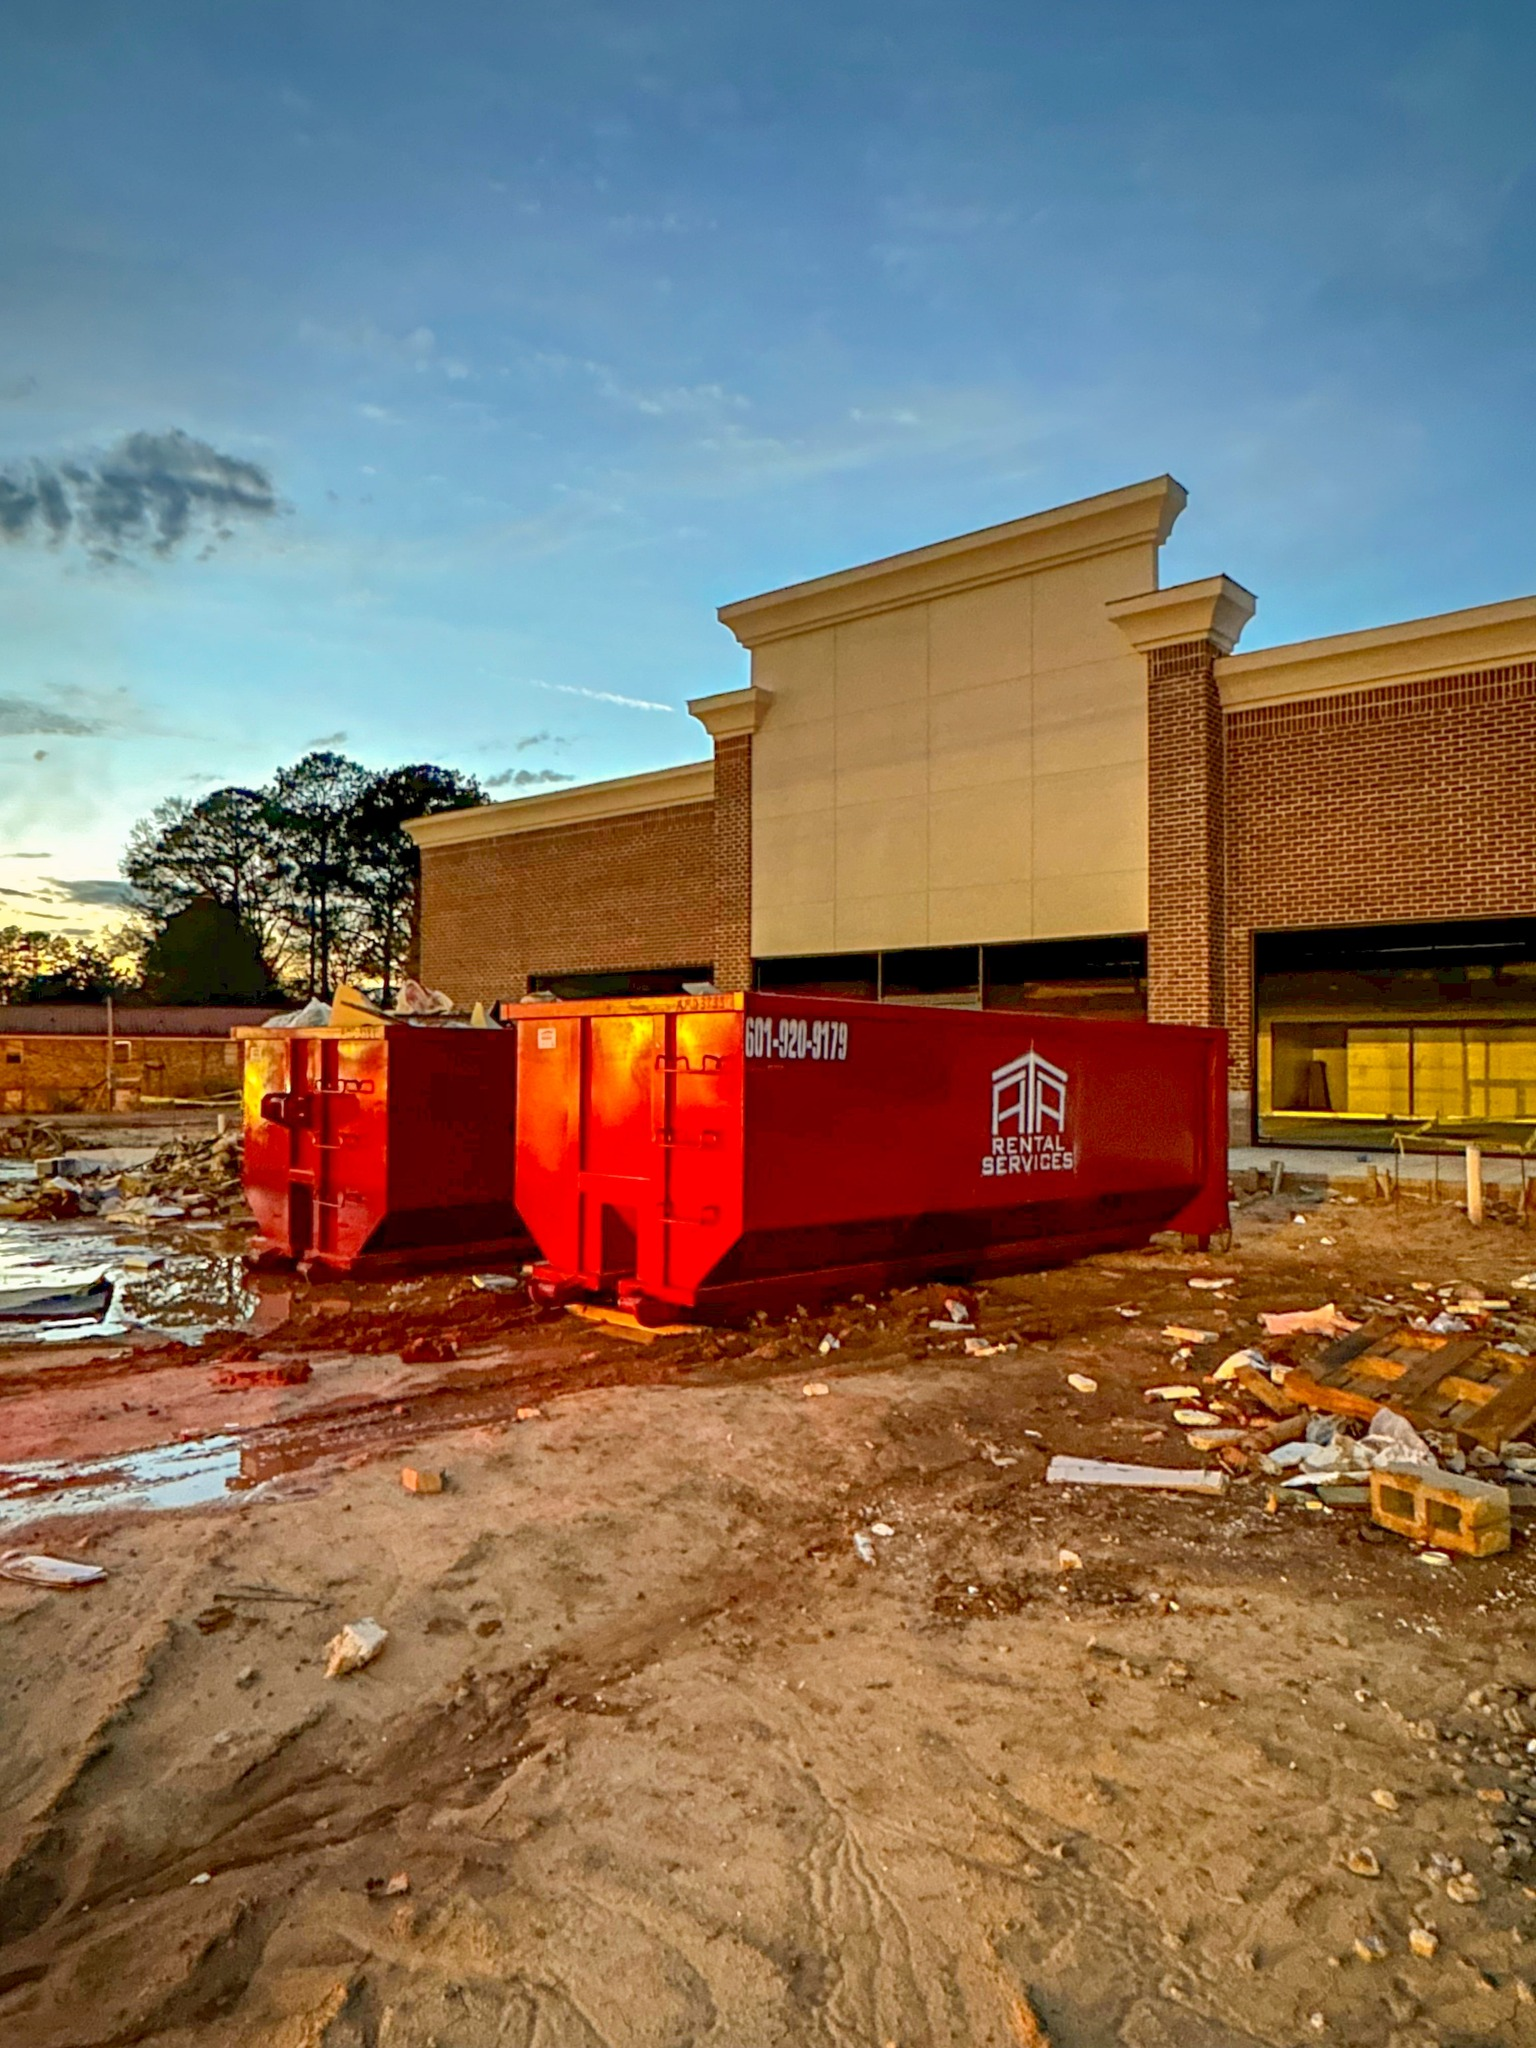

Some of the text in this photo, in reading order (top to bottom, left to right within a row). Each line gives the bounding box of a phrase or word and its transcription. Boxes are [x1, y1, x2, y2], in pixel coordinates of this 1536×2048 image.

[745, 1016, 848, 1060] 601-920-9179
[991, 1134, 1066, 1156] RENTAL
[981, 1151, 1074, 1176] SERVICES
